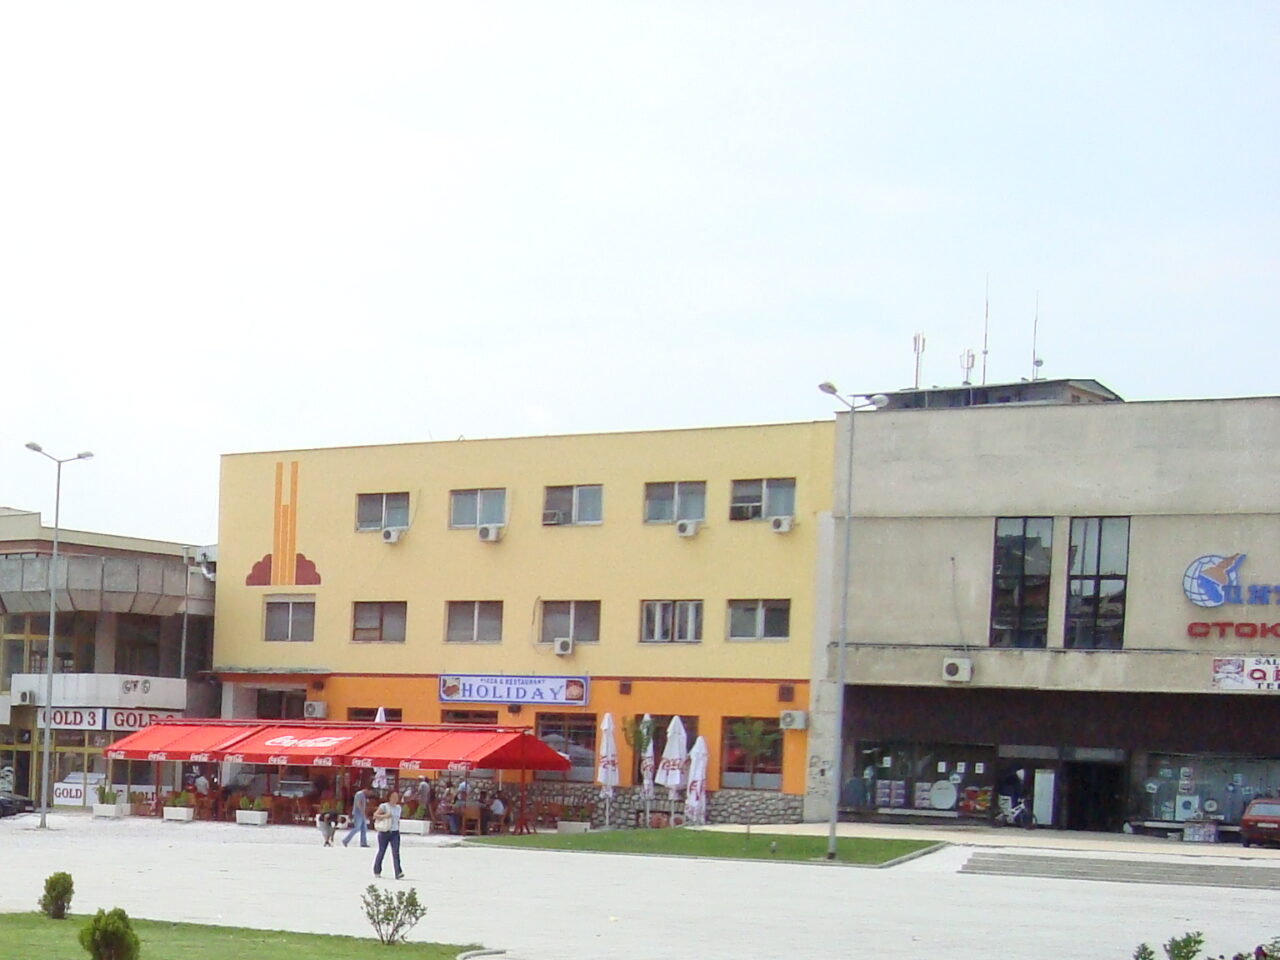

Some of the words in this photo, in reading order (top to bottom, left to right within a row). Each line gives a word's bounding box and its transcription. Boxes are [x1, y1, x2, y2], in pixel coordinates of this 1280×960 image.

[461, 682, 564, 700] HOLIDAY
[87, 711, 97, 726] 3
[54, 787, 82, 799] GOLD
